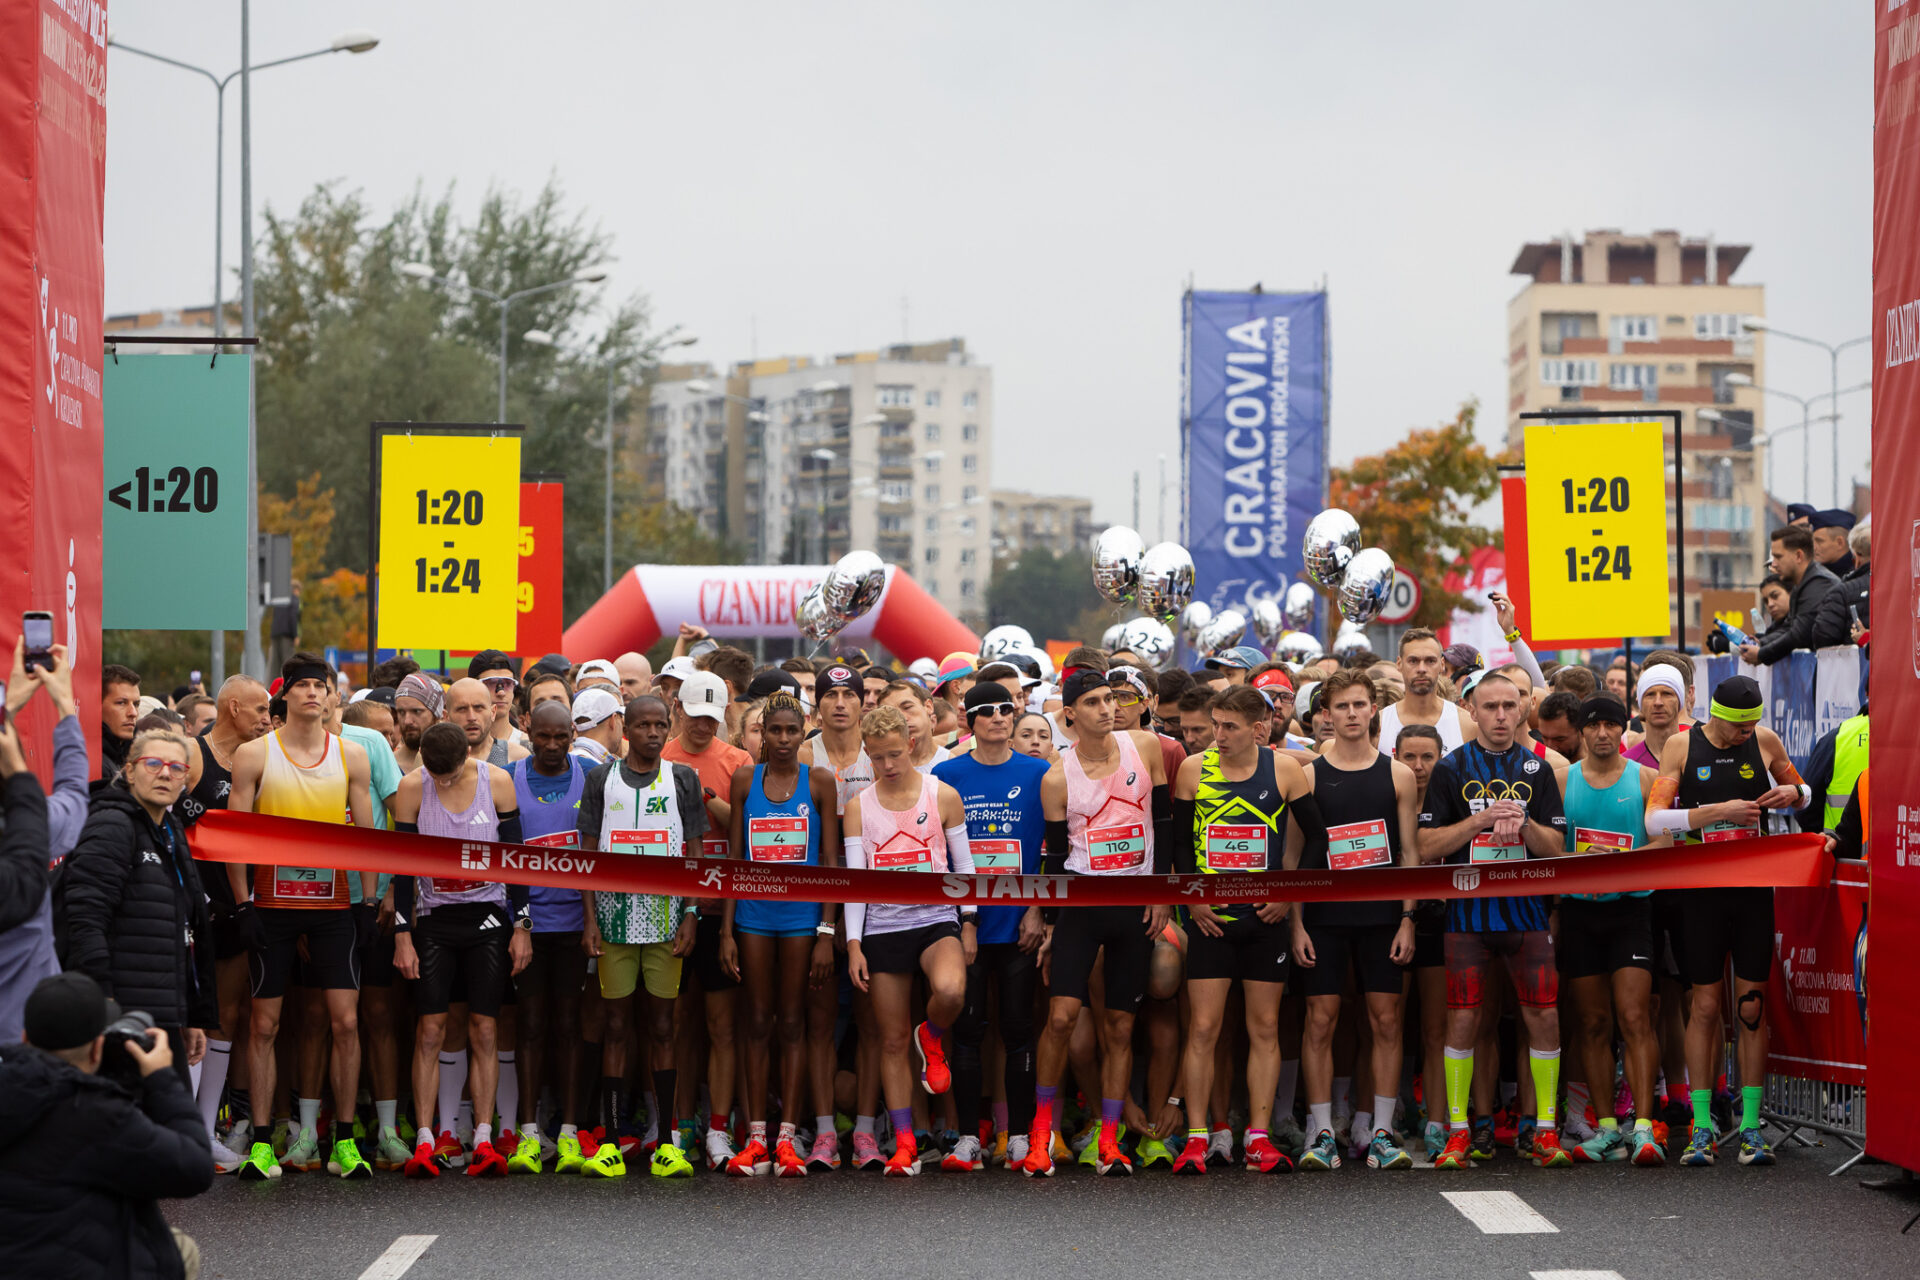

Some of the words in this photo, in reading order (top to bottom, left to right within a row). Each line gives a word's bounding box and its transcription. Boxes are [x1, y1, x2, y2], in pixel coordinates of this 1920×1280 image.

[1269, 316, 1291, 427] KRÓLEWSKI
[1225, 316, 1268, 558] CRACOVIA
[108, 466, 219, 514] <1:20
[1269, 430, 1289, 559] PÓŁMARATON
[1562, 476, 1630, 514] 1:20
[416, 489, 484, 526] 1:20
[1565, 545, 1632, 582] 1:24
[415, 557, 481, 594] 1:24
[699, 578, 813, 626] CZANIEC
[1394, 581, 1411, 608] 0
[773, 833, 785, 843] 4
[1105, 841, 1130, 853] 110
[1225, 841, 1249, 851] 46
[1349, 838, 1366, 850] 15
[501, 850, 596, 874] Kraków
[986, 856, 997, 865] 7
[1491, 848, 1508, 859] 71
[296, 869, 316, 880] 73
[732, 874, 783, 883] CRACOVIA
[784, 875, 850, 887] PÓŁMARATON
[1488, 869, 1518, 880] Bank
[1521, 867, 1556, 879] Polski
[732, 882, 788, 894] KRÓLEWSKI
[941, 873, 1075, 900] START
[1215, 881, 1263, 889] CRACOVIA
[1215, 888, 1269, 898] KRÓLEWSKI
